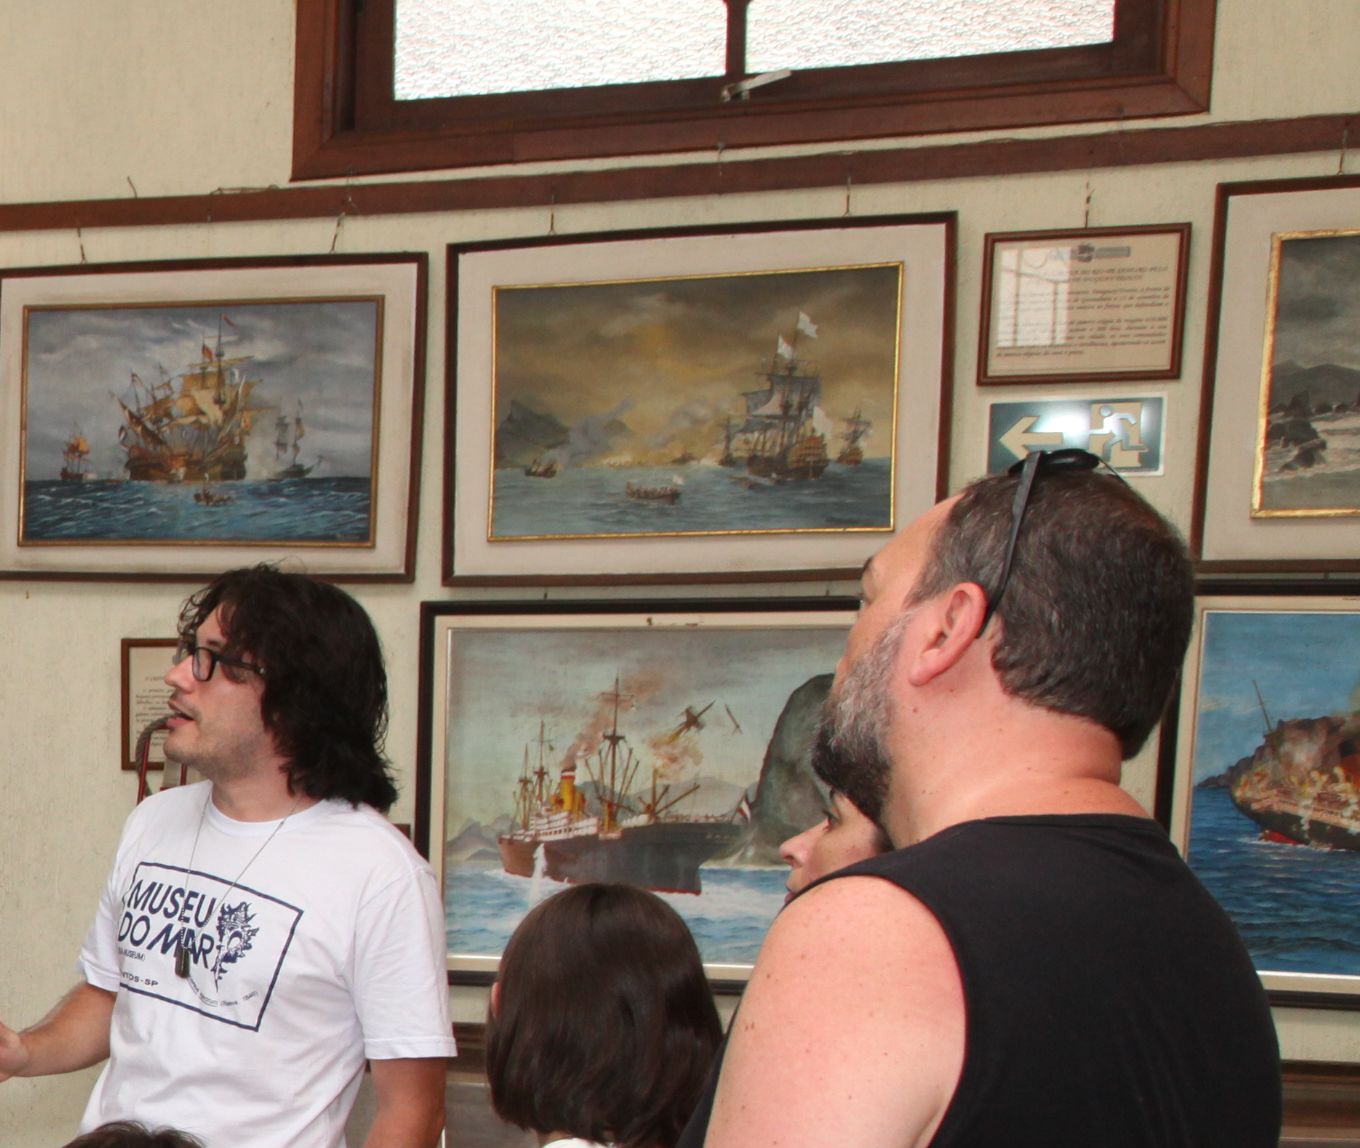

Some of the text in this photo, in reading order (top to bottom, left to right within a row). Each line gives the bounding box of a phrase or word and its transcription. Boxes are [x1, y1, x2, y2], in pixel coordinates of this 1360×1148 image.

[127, 879, 217, 928] MUSEU
[118, 911, 215, 969] DO MAR
